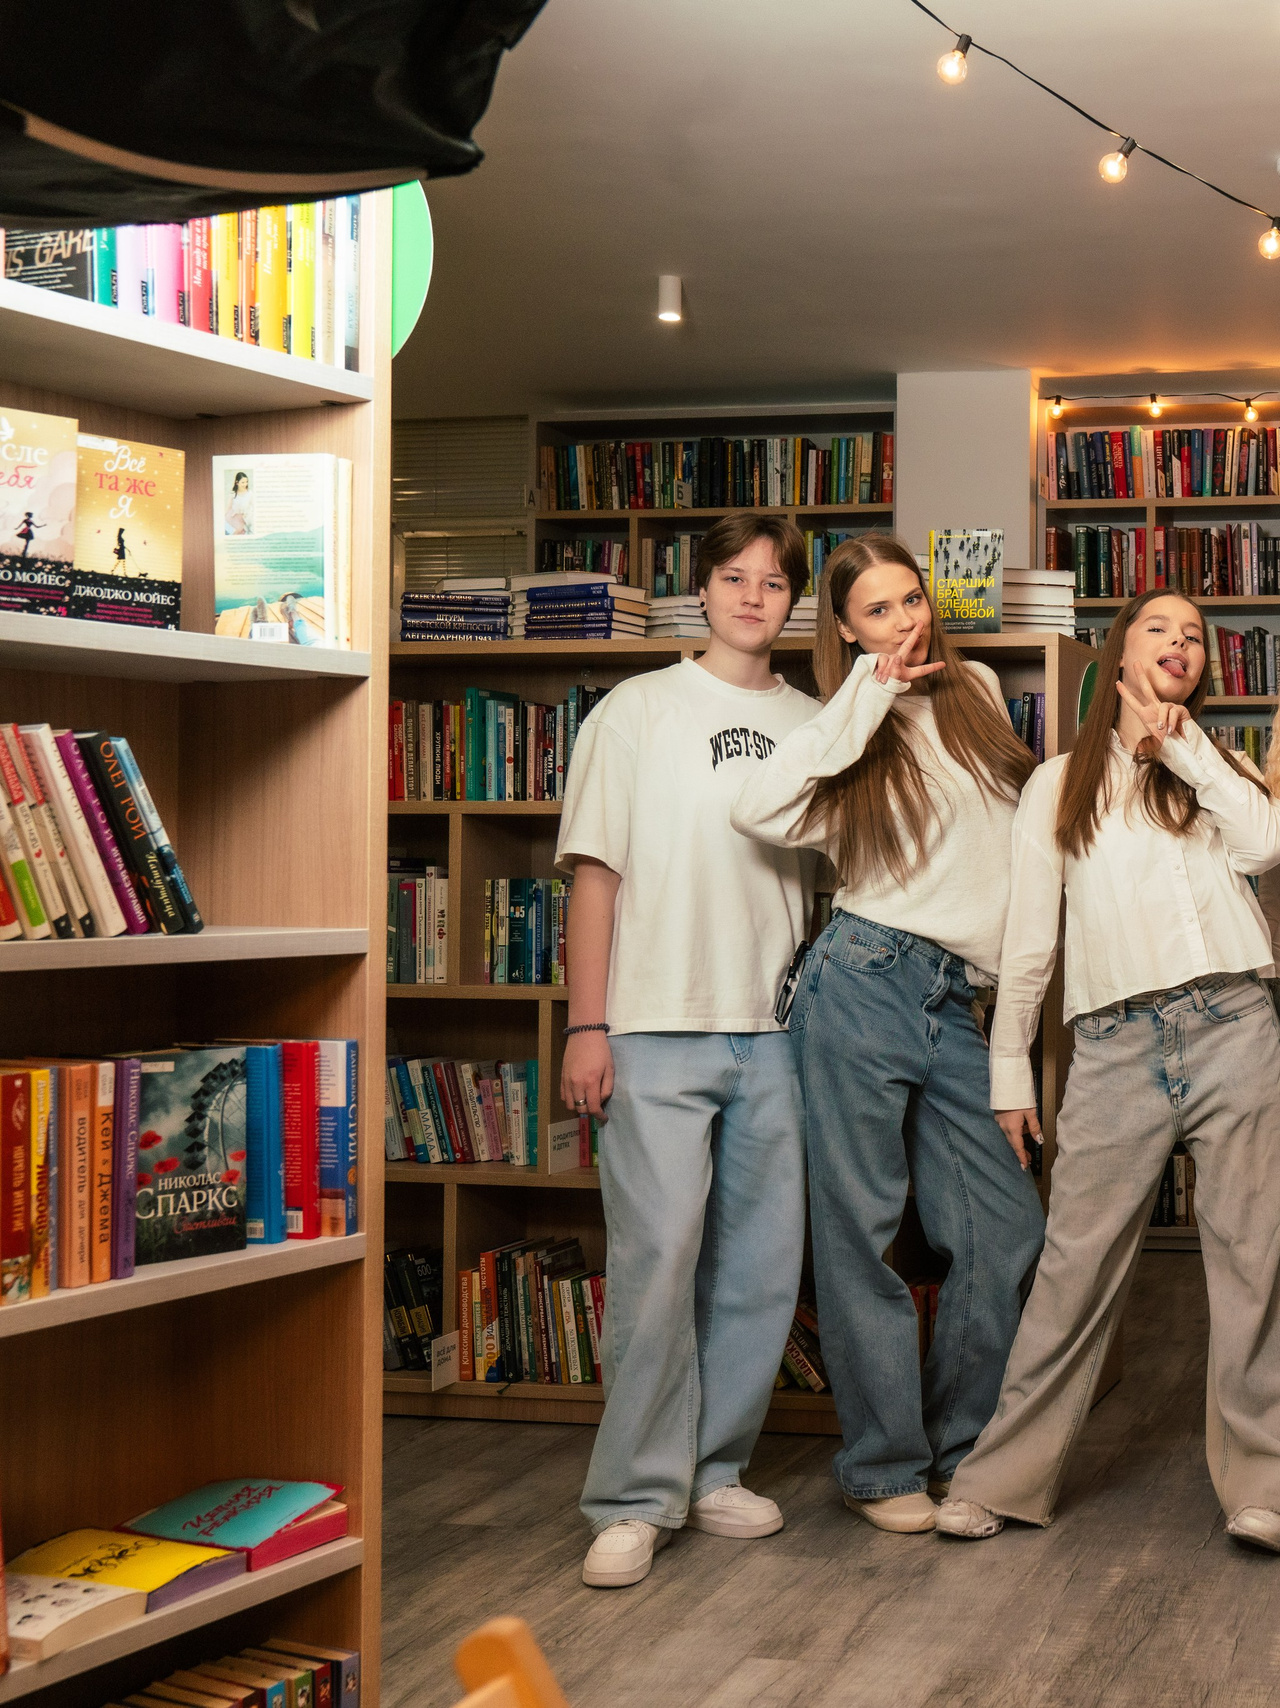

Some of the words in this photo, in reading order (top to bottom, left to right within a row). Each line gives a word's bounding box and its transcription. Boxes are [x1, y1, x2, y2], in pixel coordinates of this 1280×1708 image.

[0, 442, 49, 465] сле
[104, 445, 147, 474] Всё
[0, 465, 39, 490] ебя
[94, 471, 122, 492] та
[126, 476, 156, 497] же
[14, 570, 66, 588] МОЙЕС
[937, 576, 995, 589] СТАРШИЙ
[937, 588, 965, 599] БРАТ
[72, 584, 131, 601] ДЖОДЖО
[132, 591, 175, 607] МОЙЕС
[936, 598, 985, 611] СЛЕДИТ
[406, 620, 451, 629] БРЕСТСКОЙ
[452, 622, 493, 632] КРЕПОСТИ
[937, 609, 951, 619] ЗА
[953, 606, 995, 619] ТОБОЙ
[405, 632, 473, 641] ЛЕГЕНДАРНЫЙ
[70, 741, 94, 791] ОЛЕГ
[92, 799, 114, 841] РОЙ
[111, 846, 126, 870] ИГРА
[120, 869, 130, 887] БЕЗ
[127, 886, 147, 924] ПРАВИЛ
[99, 740, 126, 789] ОЛЕГ
[119, 797, 147, 841] РОЙ
[145, 850, 177, 918] Натурщица
[127, 1067, 140, 1127] НИКОЛАС
[99, 1111, 113, 1151] Кей
[420, 1112, 437, 1152] МАМА
[557, 1128, 580, 1141] РОДИТЕЛ
[12, 1145, 25, 1187] КОРОЛЬ
[76, 1116, 87, 1193] водитель
[125, 1130, 138, 1179] СПАРКС
[158, 1171, 222, 1192] НИКОЛАС
[12, 1190, 25, 1232] ИНТРИГ
[36, 1163, 48, 1237] ЛЮБОВЬ
[97, 1172, 113, 1244] Джема
[135, 1186, 238, 1220] СПАРКС
[461, 1276, 470, 1328] домоводства
[461, 1329, 470, 1365] Классика
